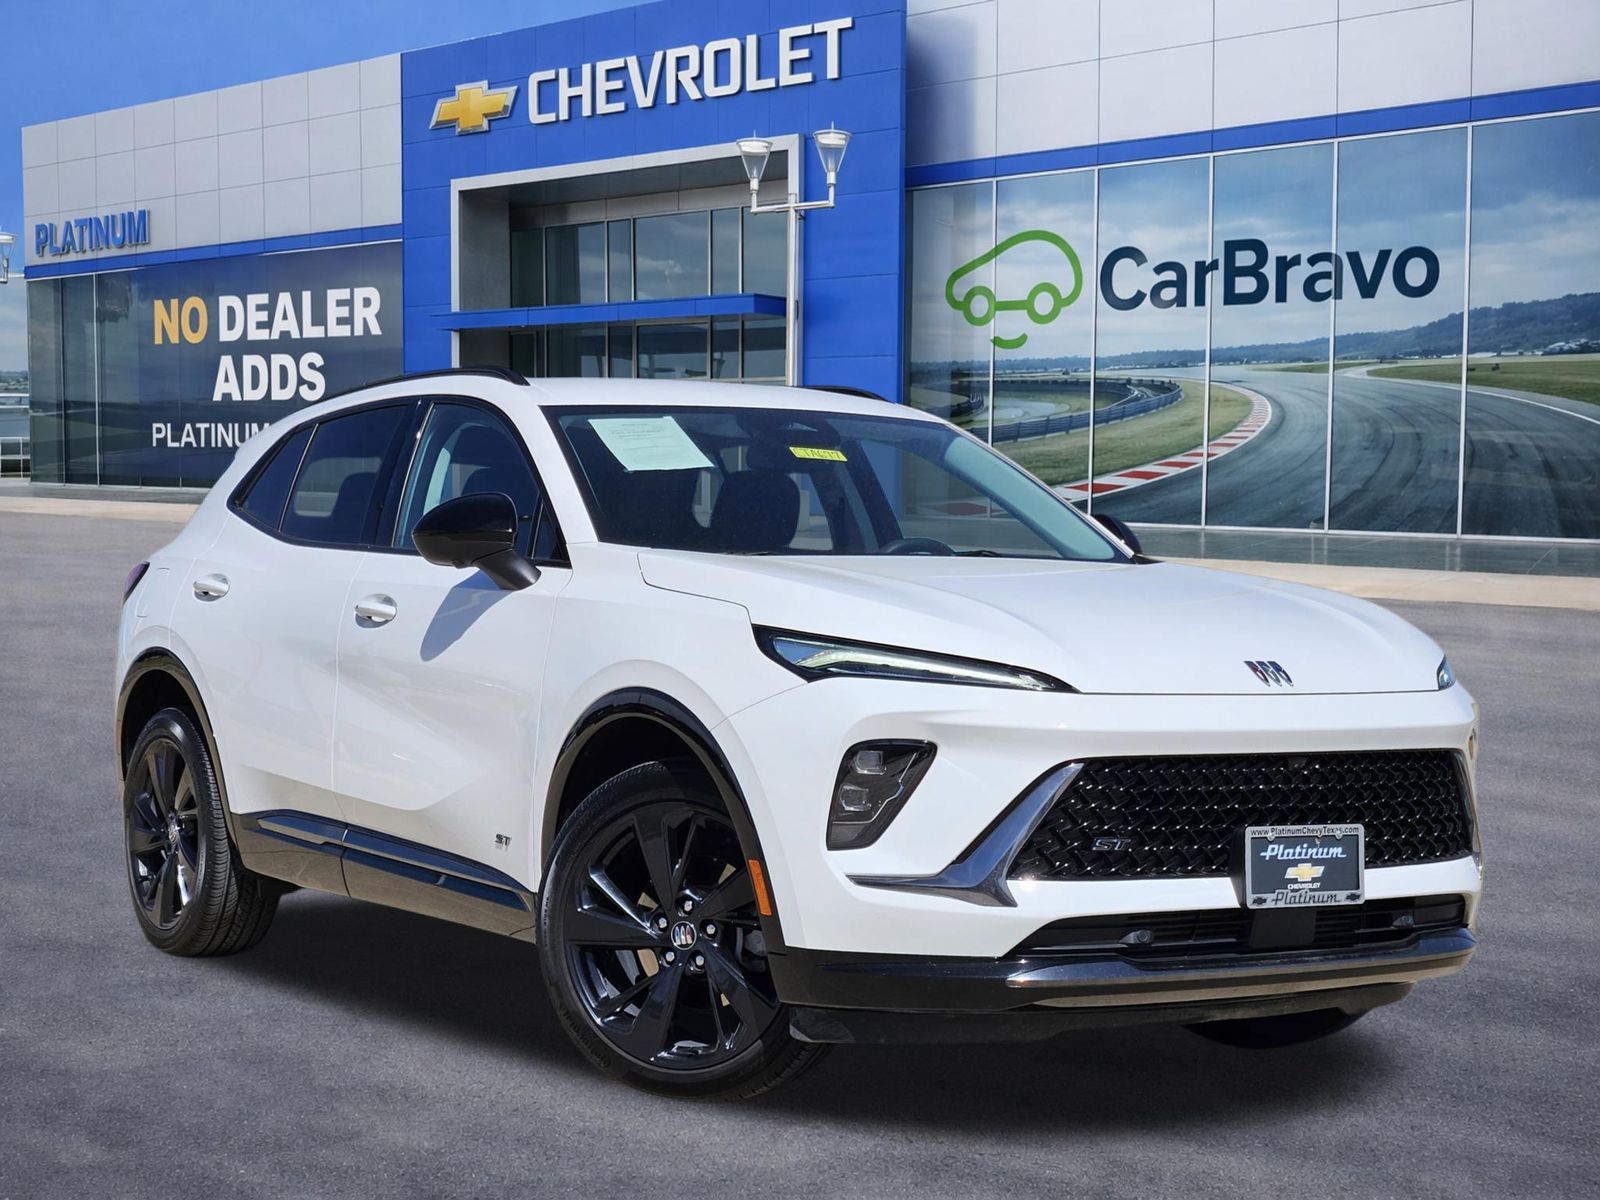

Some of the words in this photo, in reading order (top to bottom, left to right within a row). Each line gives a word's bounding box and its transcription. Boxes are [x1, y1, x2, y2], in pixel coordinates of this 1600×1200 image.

[528, 16, 853, 125] CHEVROLET
[34, 208, 150, 257] PLATINUM
[1100, 238, 1440, 311] CarBravo
[153, 296, 209, 345] NO
[218, 286, 382, 342] DEALER
[212, 351, 326, 402] ADDS
[495, 833, 512, 847] ST
[1092, 838, 1131, 851] ST
[1251, 826, 1359, 837] wwwPlatinumChevyTexas.com
[1260, 843, 1347, 860] Platinum
[1272, 889, 1339, 905] Platinum
